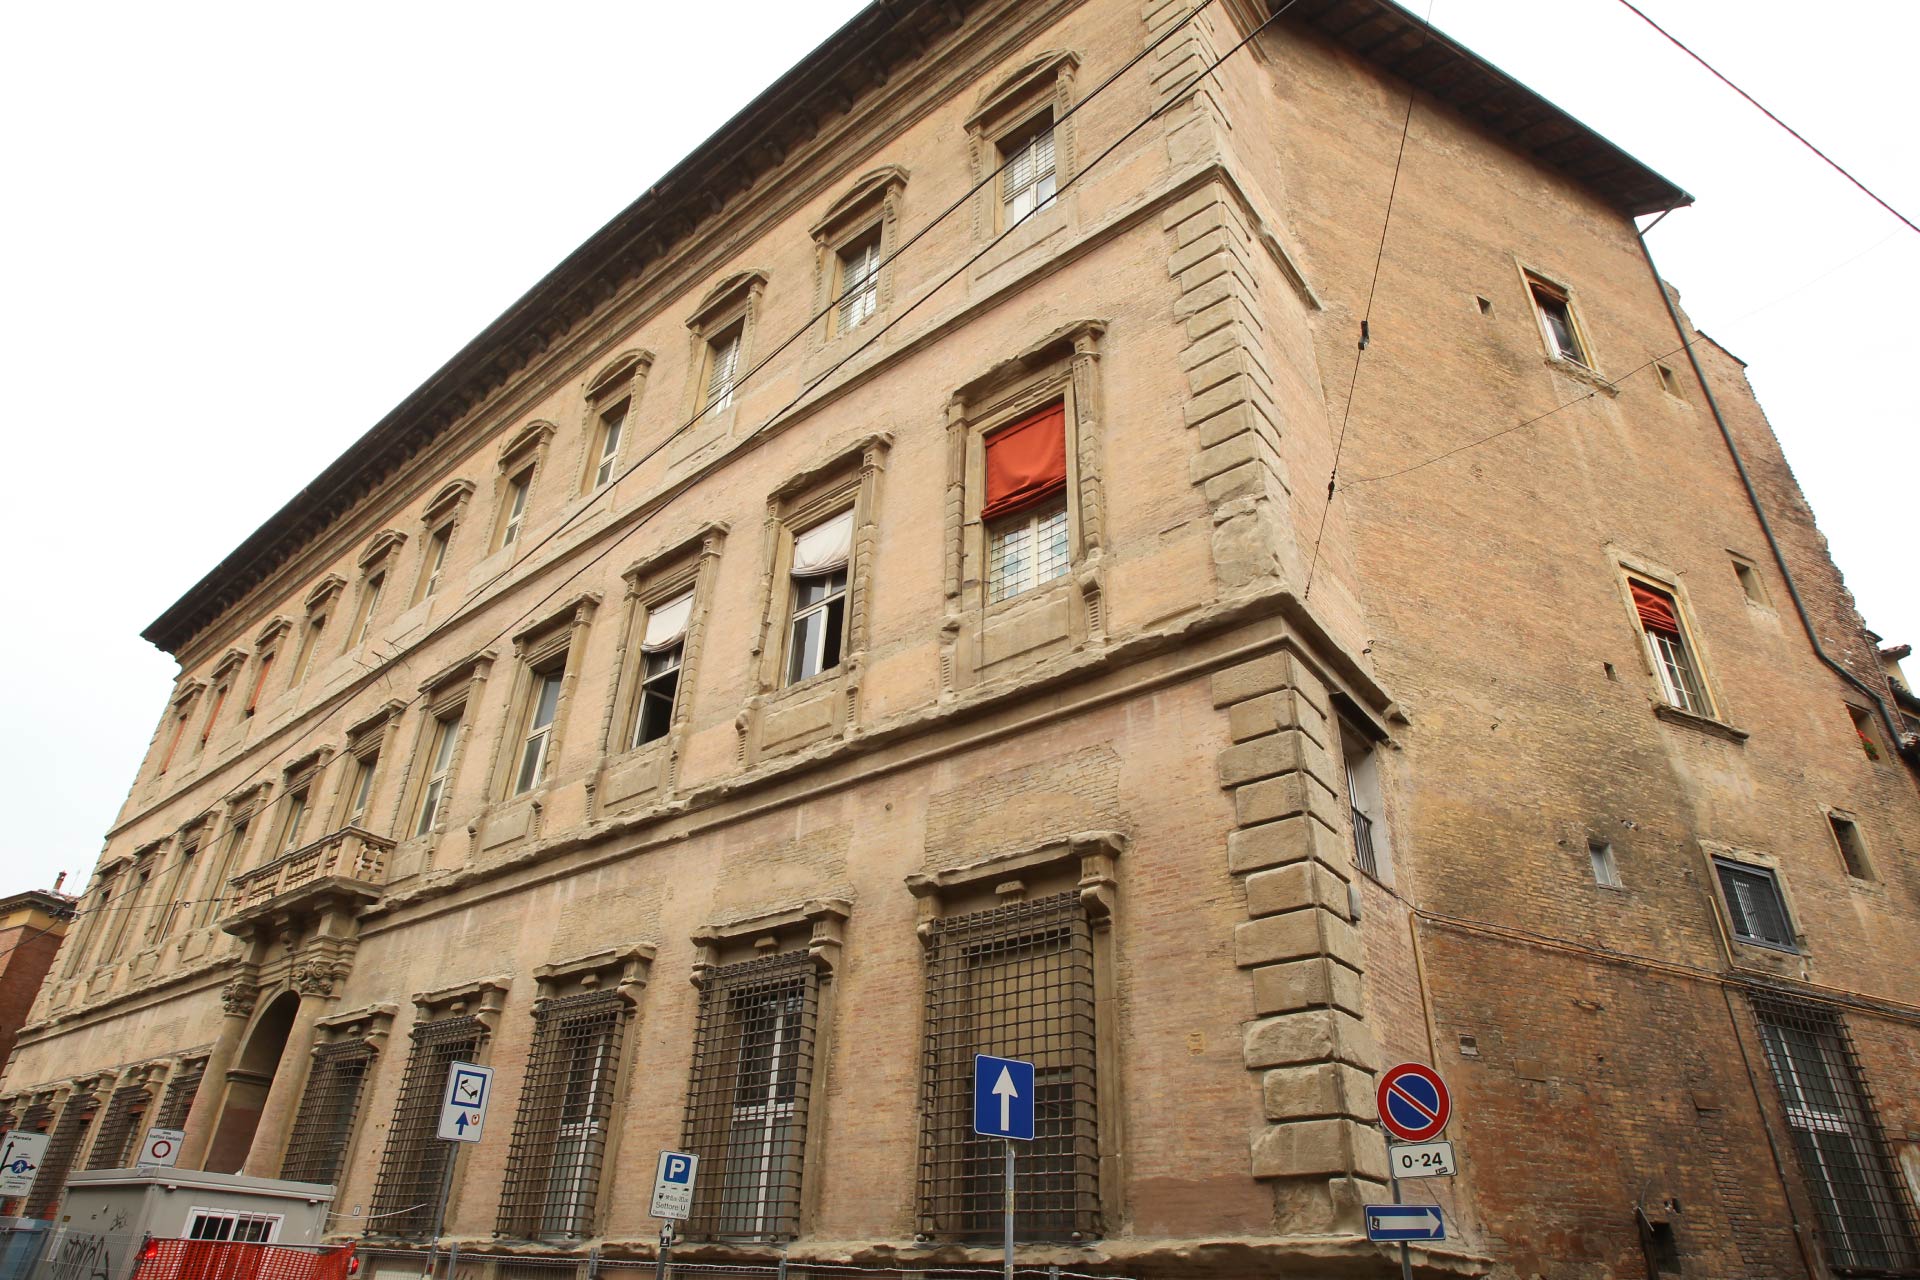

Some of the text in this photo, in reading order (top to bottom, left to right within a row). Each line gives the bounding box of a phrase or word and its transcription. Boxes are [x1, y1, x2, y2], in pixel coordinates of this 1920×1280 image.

[1402, 1152, 1442, 1168] 0-24
[669, 1158, 685, 1179] P
[655, 1201, 679, 1211] Settore
